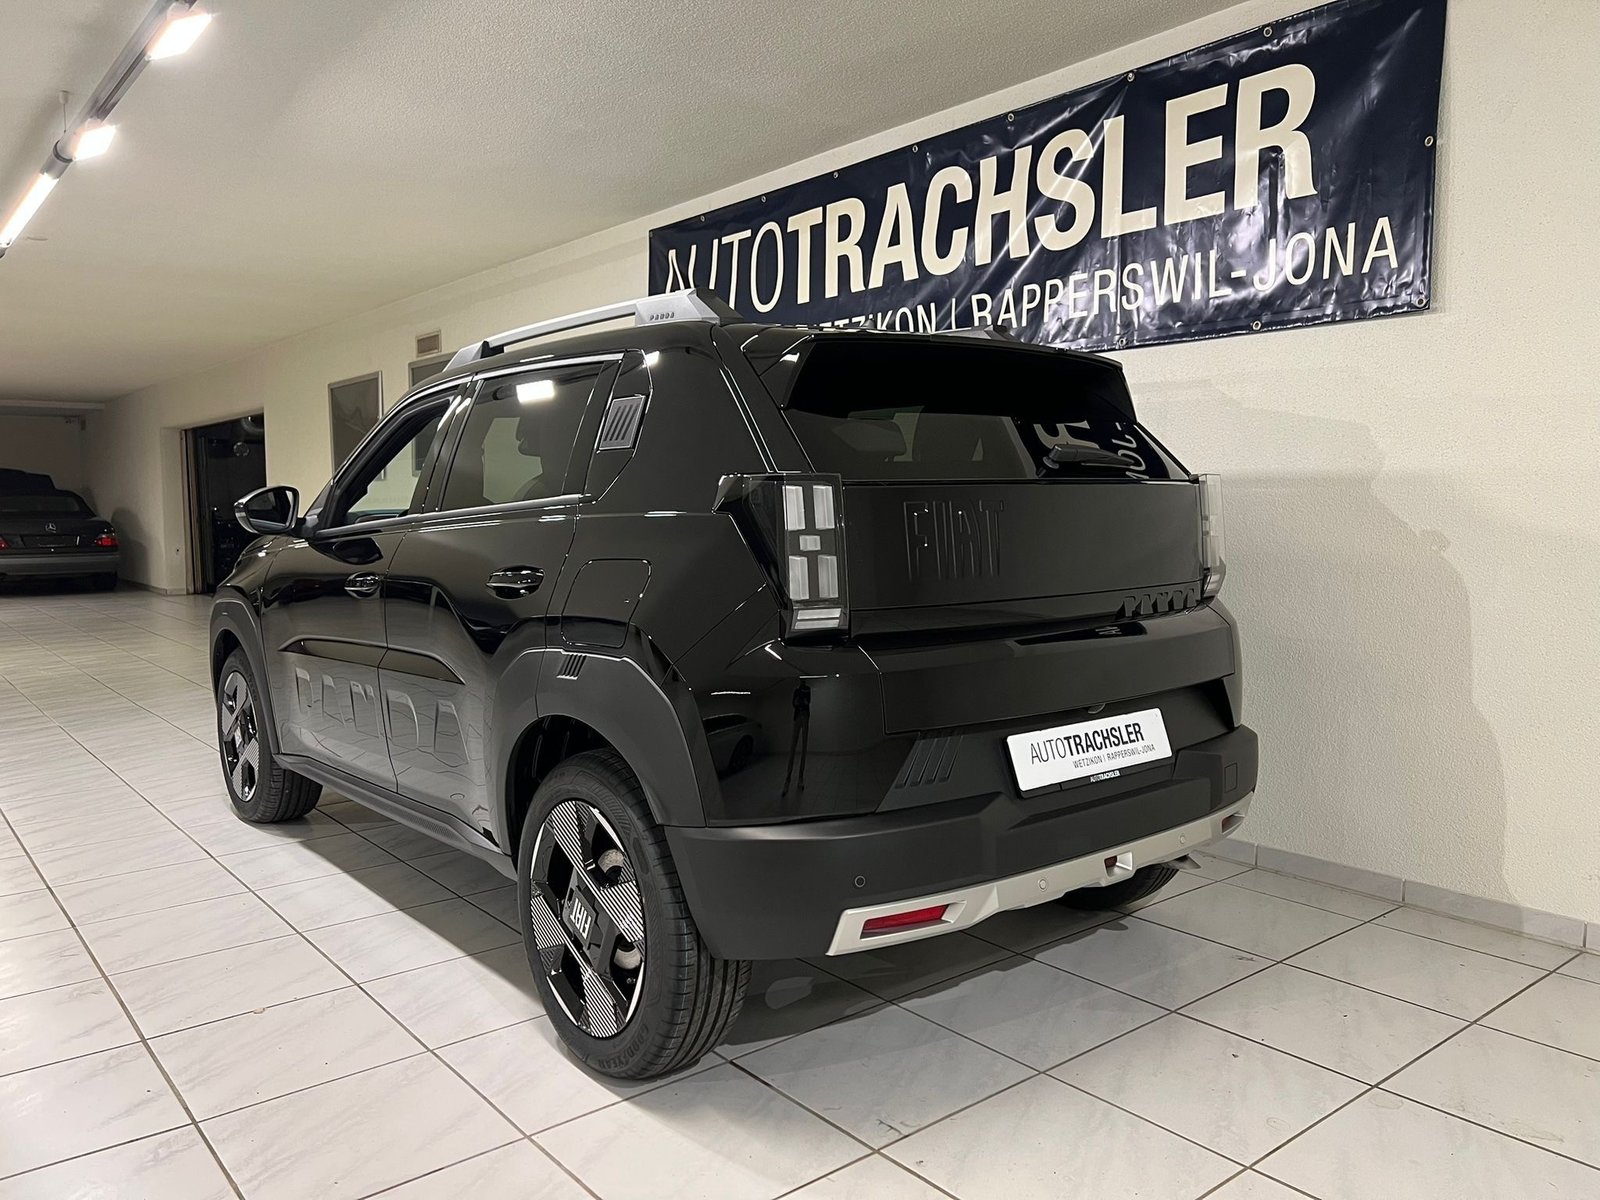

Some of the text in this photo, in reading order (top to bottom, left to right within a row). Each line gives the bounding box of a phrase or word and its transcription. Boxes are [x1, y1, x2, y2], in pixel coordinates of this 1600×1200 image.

[666, 63, 1317, 313] AUTOTRACHSLER
[971, 216, 1399, 329] RAPPERSWIL-JONA
[649, 311, 676, 321] PANDA
[903, 499, 1004, 582] FIAT
[1030, 722, 1145, 765] AUTOTRACHSLER
[1072, 755, 1102, 769] WETZIKON
[1106, 744, 1156, 762] RAPPERSWIL-JONA
[569, 897, 592, 940] FIAT
